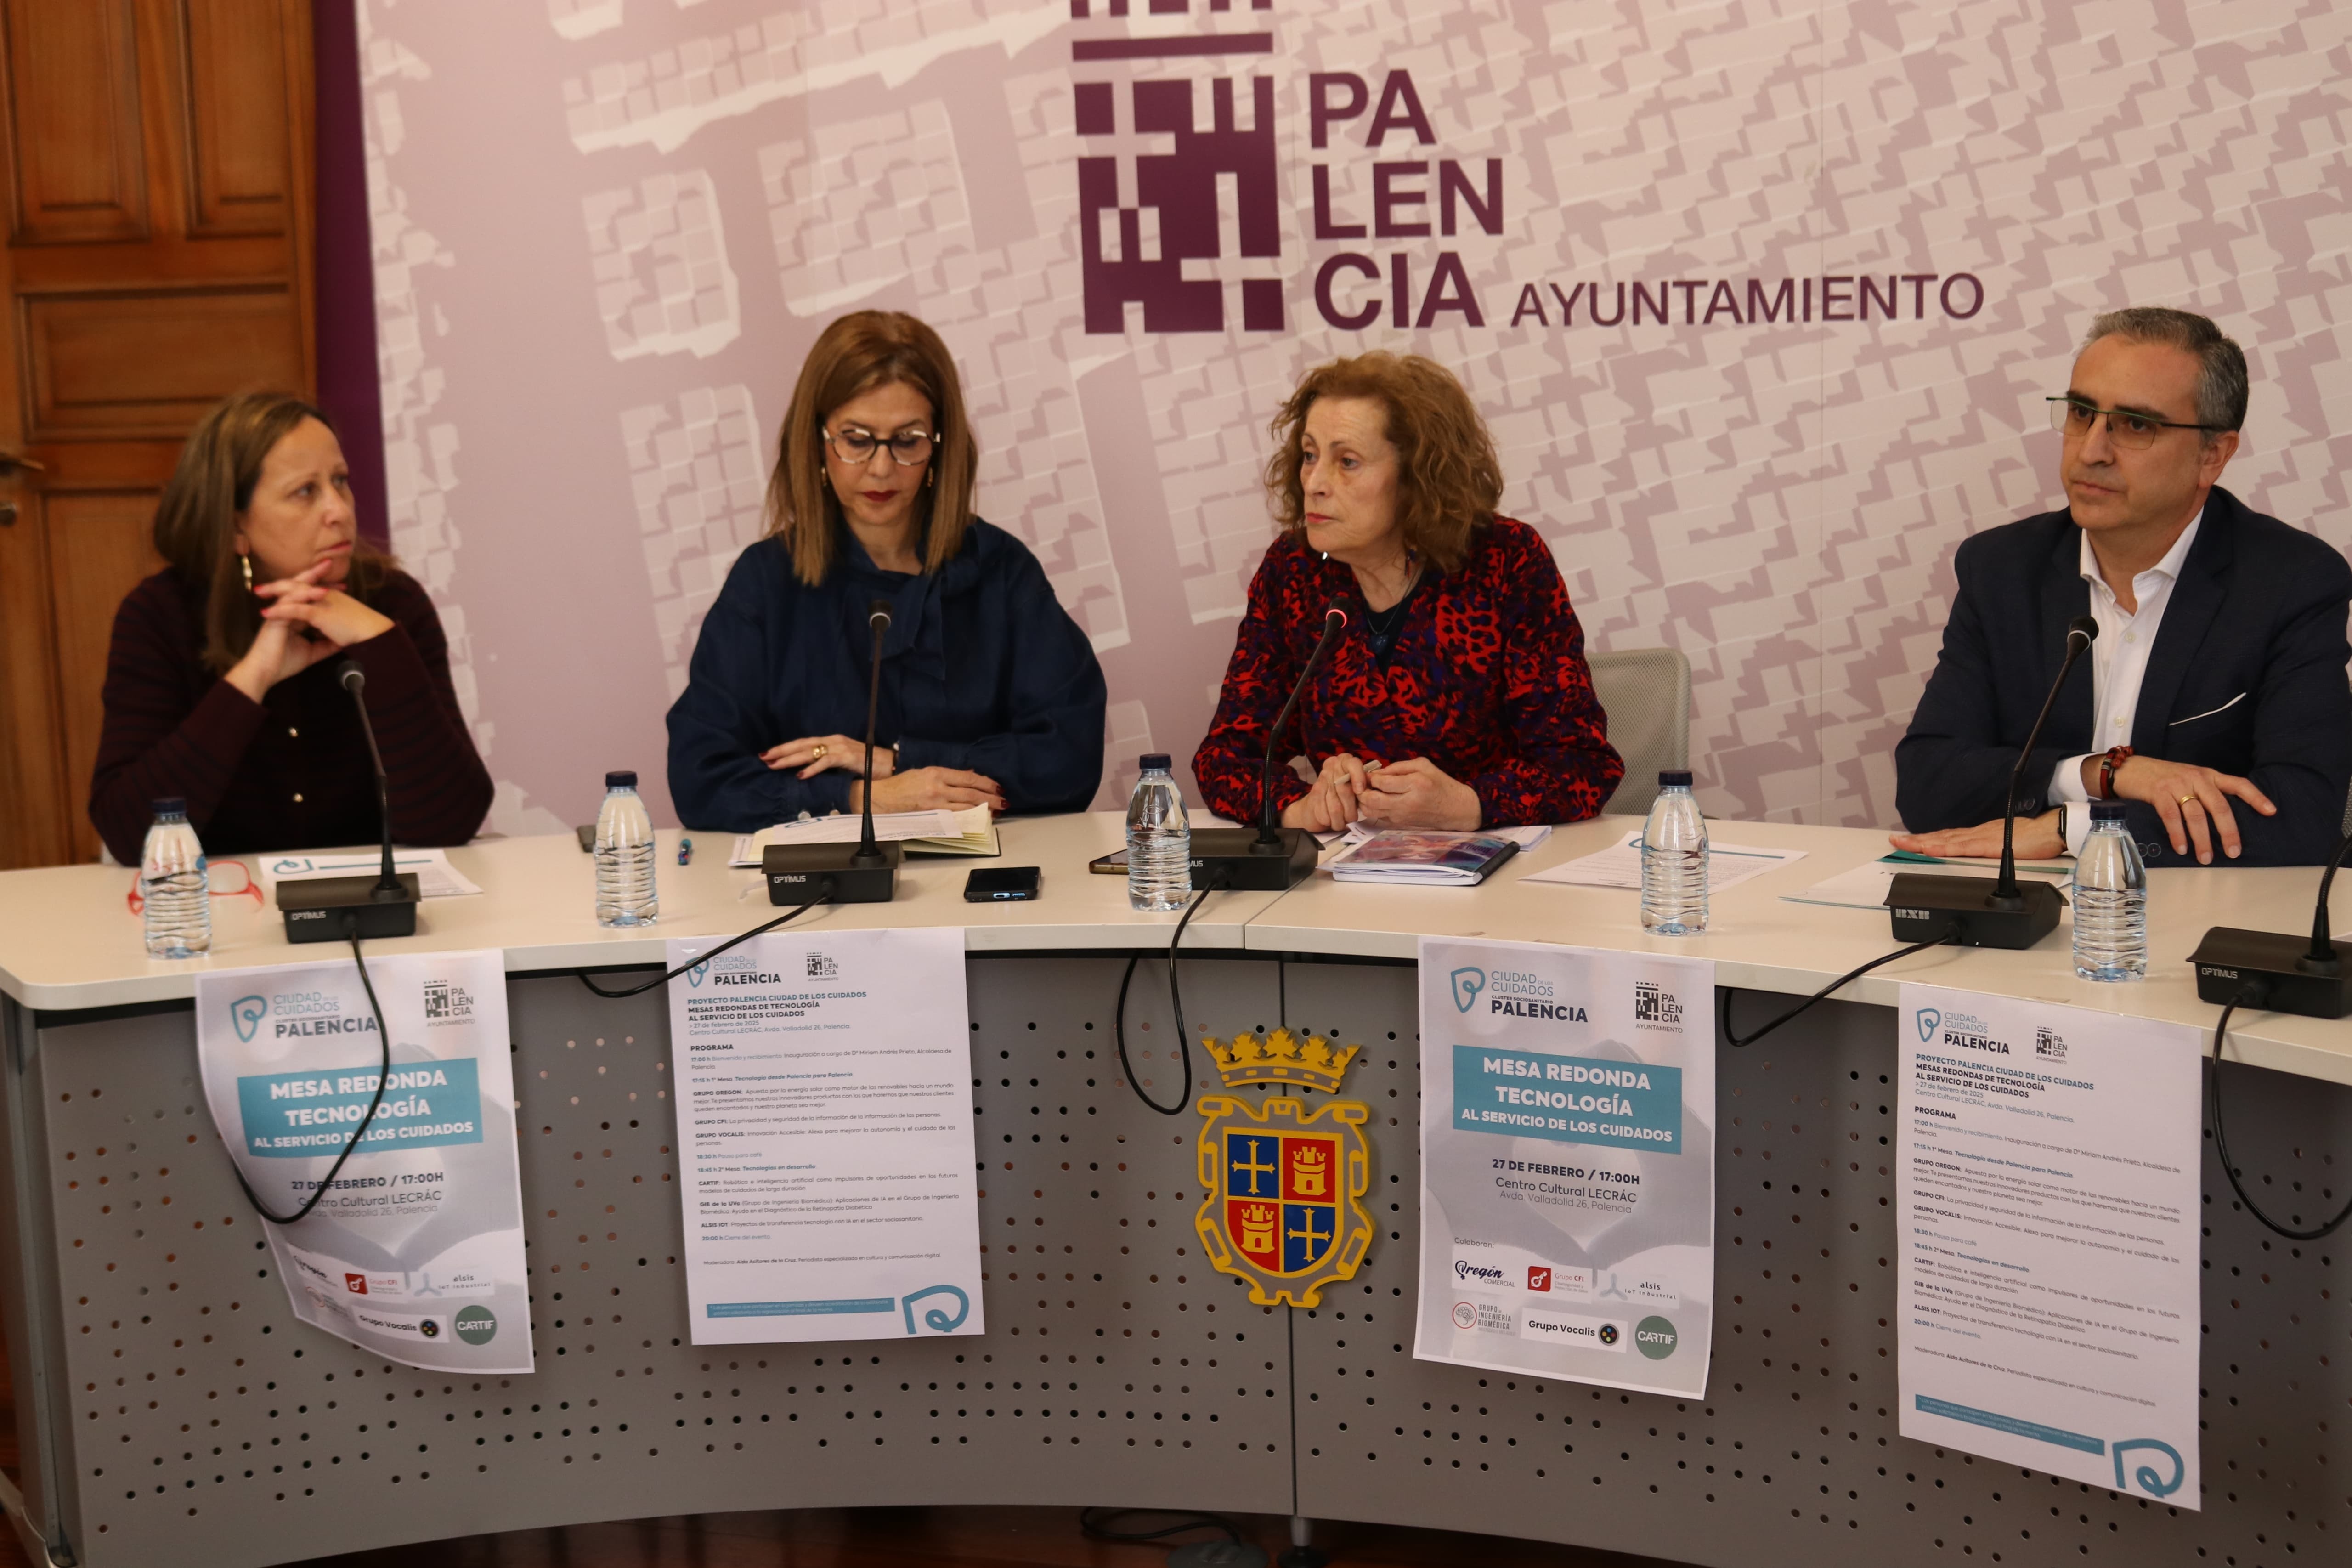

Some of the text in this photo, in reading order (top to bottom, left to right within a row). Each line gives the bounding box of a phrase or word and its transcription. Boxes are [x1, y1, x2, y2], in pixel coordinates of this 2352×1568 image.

[1309, 68, 1436, 149] PA
[1312, 158, 1504, 240] LEN
[1315, 252, 1486, 331] CIA
[1510, 272, 1984, 328] AYUNTAMIENTO
[713, 962, 757, 971] CUIDADOS
[714, 974, 781, 985] PALENCIA
[1491, 970, 1536, 984] CIUDAD
[451, 987, 465, 996] PA
[1491, 981, 1553, 996] CUIDADOS
[274, 992, 321, 1005] CIUDAD
[452, 996, 473, 1006] LEN
[1662, 993, 1675, 1003] PA
[273, 1001, 339, 1016] CUIDADOS
[452, 1006, 472, 1016] CIA
[1492, 999, 1588, 1022] PALENCIA
[1662, 1003, 1682, 1014] LEN
[1662, 1013, 1680, 1023] CIA
[1945, 1012, 1977, 1023] CIUDAD
[275, 1016, 378, 1038] PALENCIA
[1636, 1024, 1683, 1033] AYUNTAMIENTO
[1944, 1020, 1988, 1033] CUIDADOS
[1945, 1033, 2009, 1054] PALENCIA
[2053, 1042, 2067, 1051] LEN
[2053, 1049, 2065, 1058] CIA
[2035, 1056, 2067, 1065] AYUNTAMIENTO
[1484, 1057, 1651, 1090] MESA REDONDA
[1916, 1053, 1956, 1065] PROYECTO
[1958, 1060, 1994, 1072] PALENCIA
[1995, 1067, 2024, 1077] CIUDAD
[2037, 1074, 2052, 1082] LOS
[2053, 1077, 2093, 1090] CUIDADOS
[1916, 1063, 1941, 1073] MESAS
[1943, 1067, 1983, 1080] REDONDAS
[1996, 1076, 2045, 1091] TECNOLOGÍA
[271, 1070, 447, 1099] MESA REDONDA
[1926, 1074, 1961, 1085] SERVICIO
[1974, 1082, 1989, 1091] LOS
[1990, 1085, 2029, 1098] CUIDADOS
[1937, 1084, 1959, 1093] febrero
[1969, 1090, 1983, 1098] 2025
[1495, 1086, 1633, 1116] TECNOLOGÍA
[1915, 1088, 1935, 1098] Centro
[1937, 1092, 1960, 1102] Cultural
[2005, 1105, 2035, 1116] Valladolid
[285, 1094, 431, 1126] TECNOLOGÍA
[1915, 1106, 1956, 1119] PROGRAMA
[1461, 1108, 1672, 1142] AL SERVICIO DE LOS CUIDADOS
[254, 1137, 272, 1148] AL
[274, 1133, 341, 1147] SERVICIO
[367, 1128, 396, 1141] LOS
[398, 1121, 474, 1138] CUIDADOS
[1492, 1158, 1640, 1184] 27 DE FEBRERO / 17:00H
[292, 1181, 303, 1190] 27
[401, 1172, 444, 1184] 17:00H
[1495, 1177, 1636, 1203] Centro Cultural LECRÁC
[1913, 1190, 1934, 1198] GRUPO
[341, 1195, 389, 1207] Cultural
[392, 1189, 442, 1204] LECRÁC
[1527, 1193, 1573, 1206] Valladolid
[1591, 1200, 1631, 1213] Palencia
[396, 1204, 438, 1214] Palencia
[1913, 1205, 1934, 1213] GRUPO
[1453, 1235, 1495, 1247] Colaboran:
[1484, 1278, 1515, 1287] COMERCIAL
[1555, 1273, 1572, 1281] Grupo
[1640, 1281, 1660, 1290] alsis
[1479, 1304, 1498, 1313] GRUPO
[385, 1321, 418, 1331] Vocalis
[457, 1320, 494, 1330] CARTIF
[1478, 1319, 1510, 1330] BIOMÉDICA
[1528, 1320, 1558, 1332] Grupo
[1560, 1324, 1595, 1336] Vocalis
[1637, 1331, 1674, 1344] CARTIF
